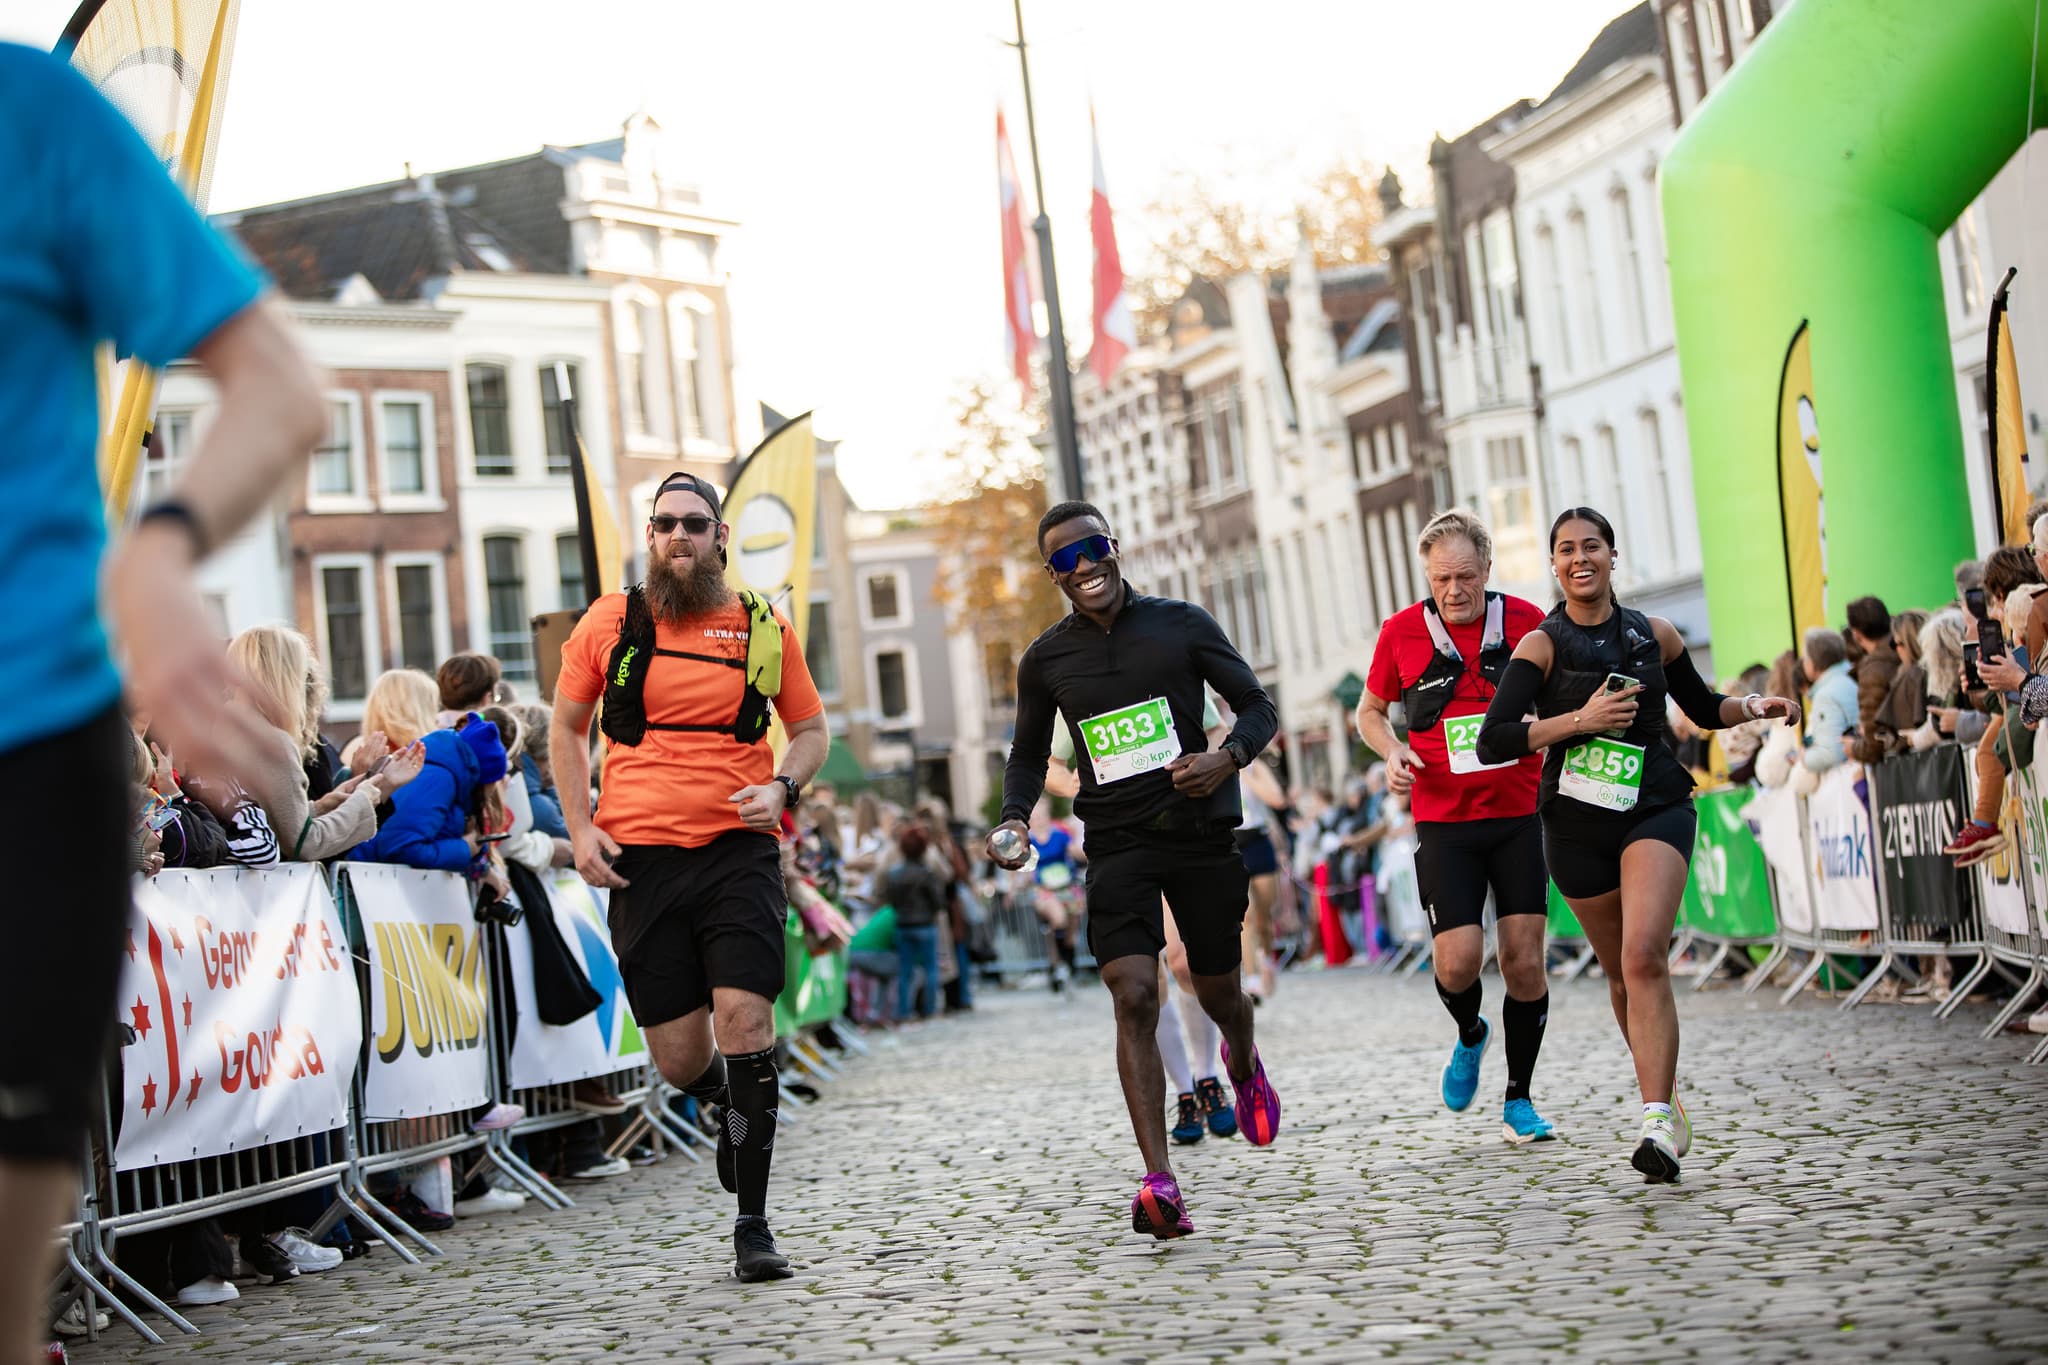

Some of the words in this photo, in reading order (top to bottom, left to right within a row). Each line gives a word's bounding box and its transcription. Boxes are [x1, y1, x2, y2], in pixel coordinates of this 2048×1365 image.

[1092, 712, 1156, 751] 3133
[1150, 750, 1172, 763] kpn
[1570, 743, 1639, 780] 2859
[1615, 794, 1637, 807] kpn
[214, 1007, 326, 1094] Gouda
